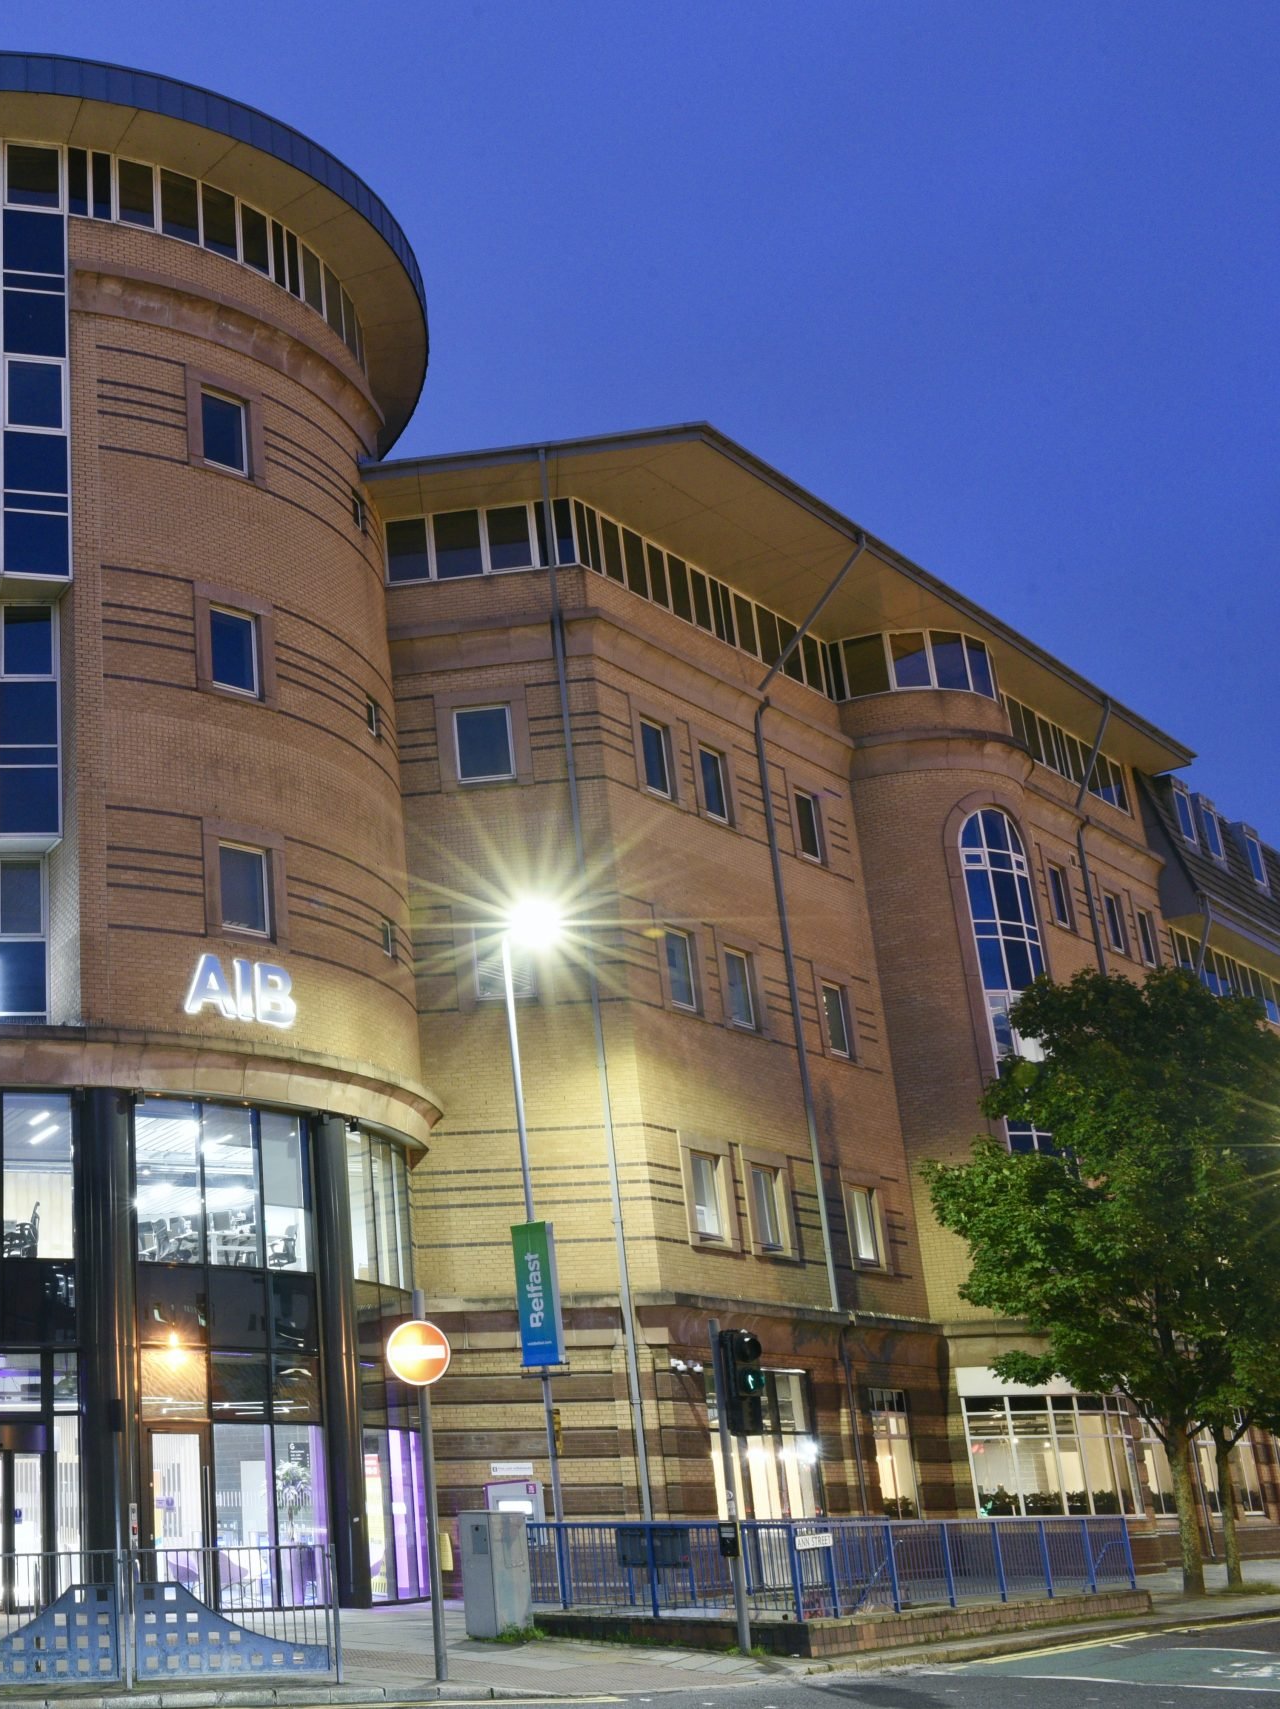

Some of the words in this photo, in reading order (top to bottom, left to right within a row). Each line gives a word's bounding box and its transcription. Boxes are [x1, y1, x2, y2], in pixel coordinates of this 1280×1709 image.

[184, 953, 297, 1029] AIB
[524, 1252, 544, 1328] Belfast
[797, 1537, 810, 1548] ANN
[812, 1535, 830, 1546] STREET
